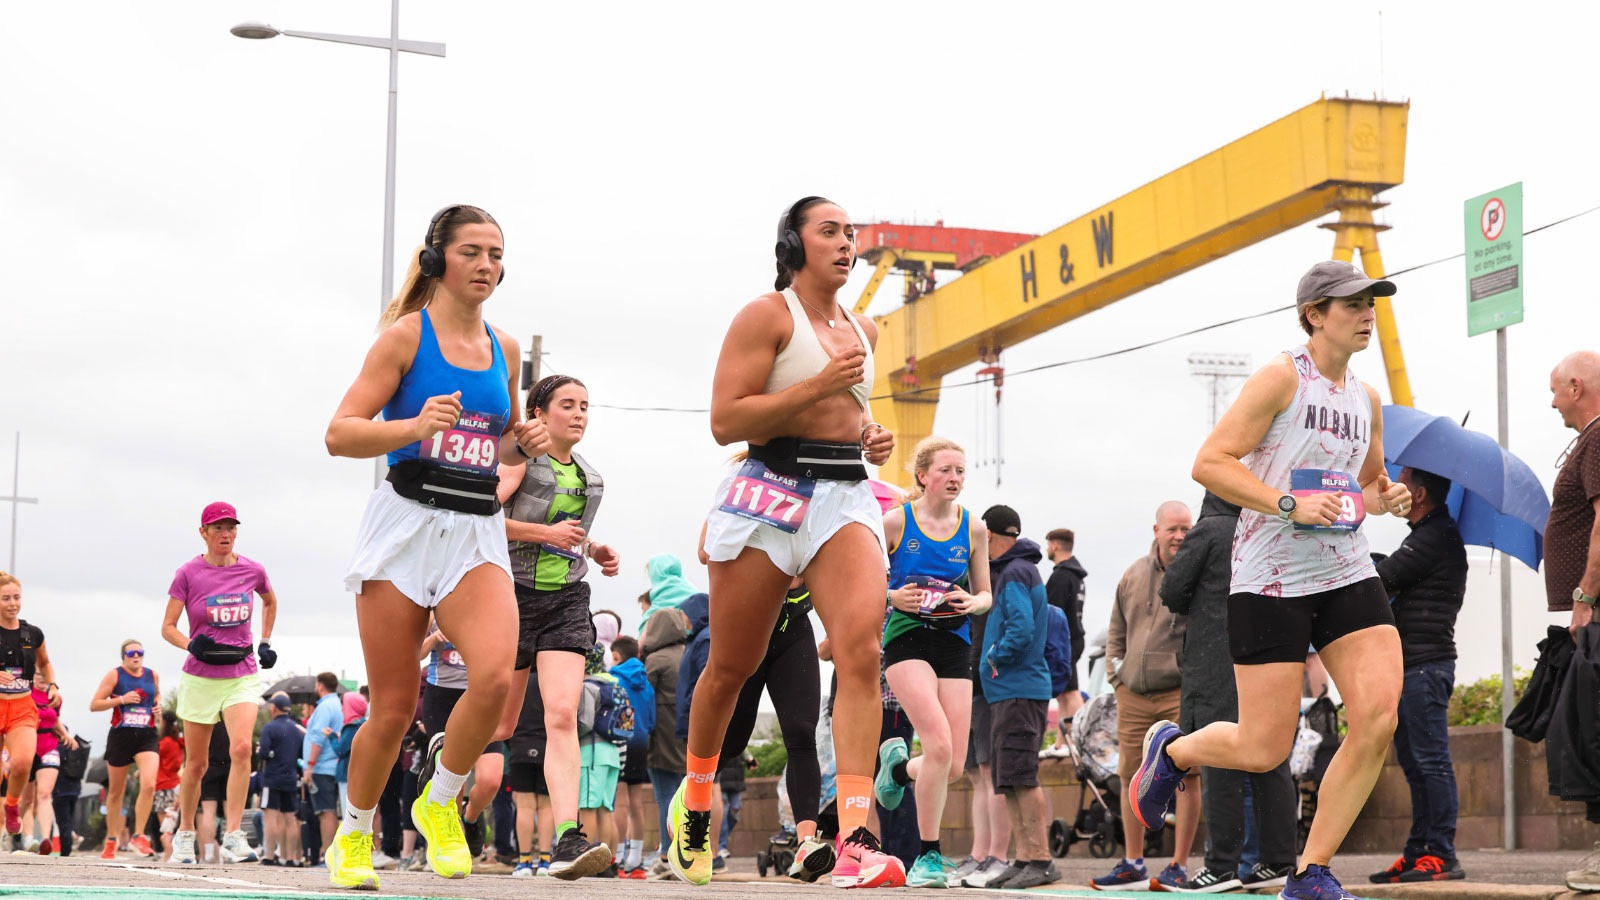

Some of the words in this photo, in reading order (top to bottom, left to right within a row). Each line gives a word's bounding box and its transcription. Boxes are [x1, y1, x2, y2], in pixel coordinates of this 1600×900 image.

[1020, 249, 1037, 302] H
[1059, 243, 1074, 285] &
[1091, 210, 1113, 268] W
[1474, 249, 1484, 258] No
[1473, 262, 1482, 272] at
[1482, 260, 1495, 270] any
[459, 418, 490, 430] BELFAST
[430, 430, 495, 468] 1349
[762, 471, 799, 488] BELFAST
[1321, 477, 1350, 487] BELFAST
[731, 479, 804, 523] 1177
[210, 605, 249, 623] 1676
